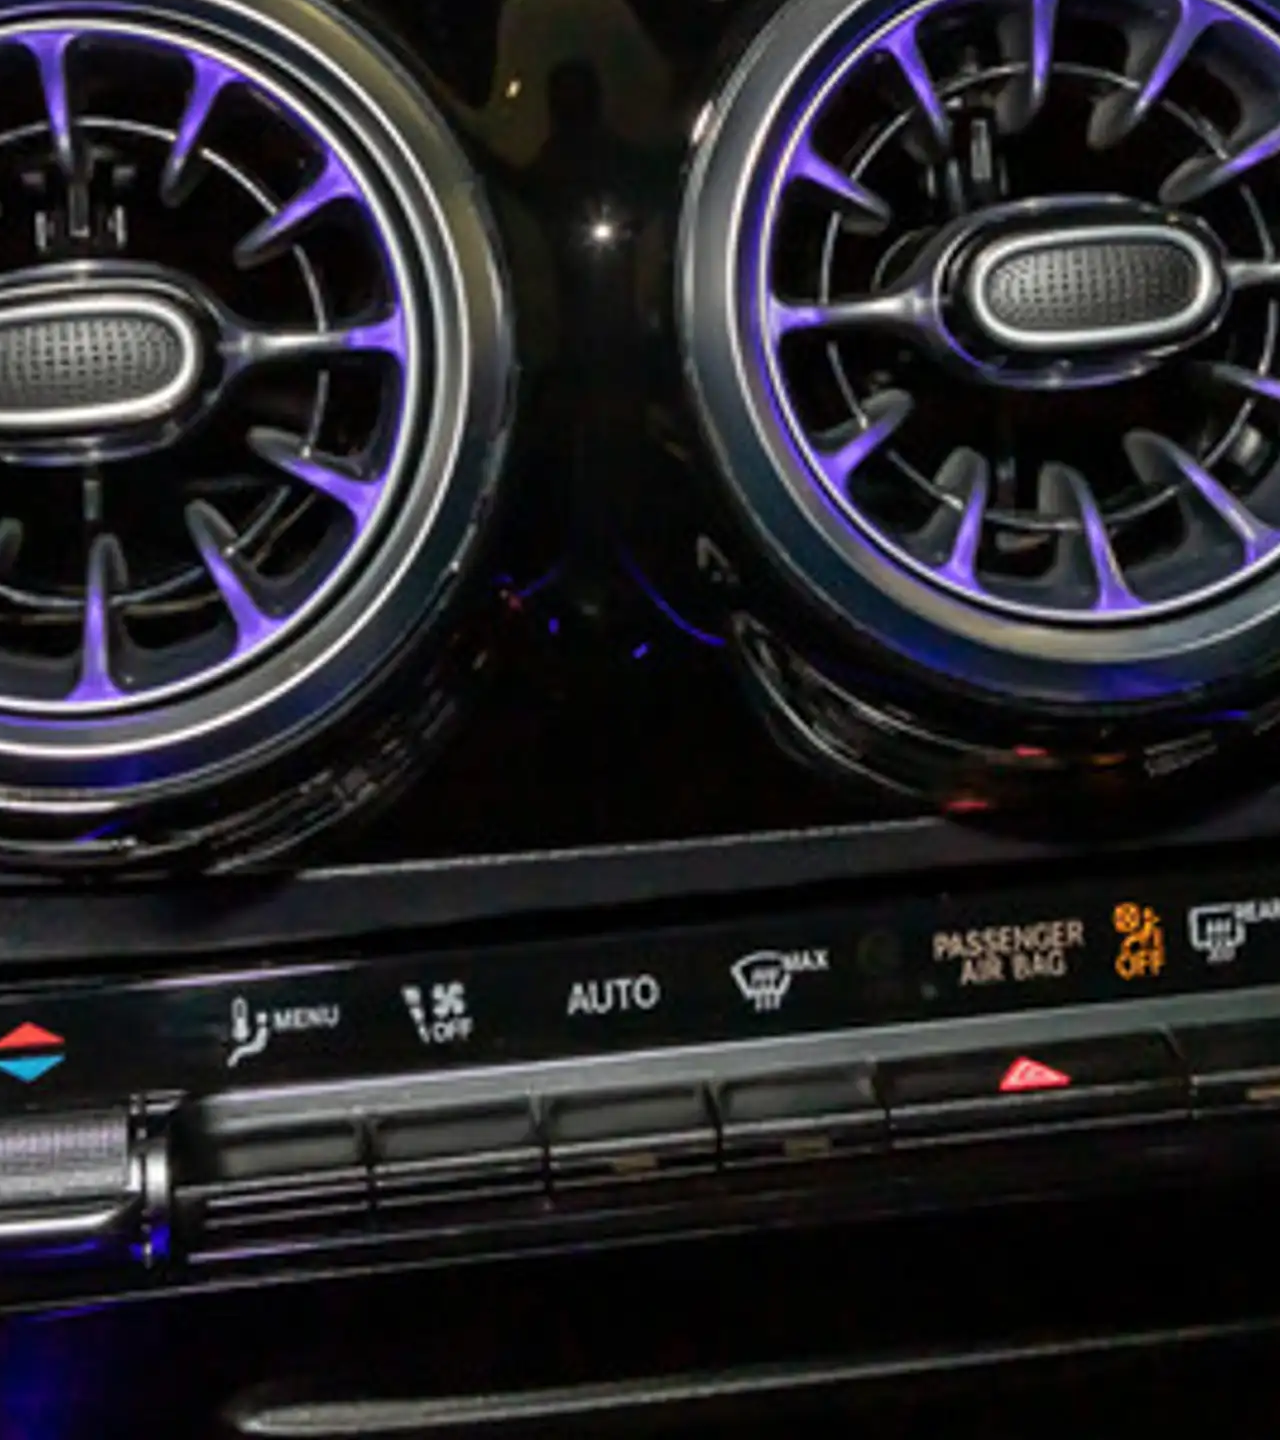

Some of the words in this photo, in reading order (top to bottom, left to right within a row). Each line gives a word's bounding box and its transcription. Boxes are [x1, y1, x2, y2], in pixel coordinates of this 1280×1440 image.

[933, 920, 1085, 960] PASSENGER
[782, 949, 830, 972] MAX
[960, 959, 1006, 986] AIR
[1014, 951, 1067, 980] BAG
[1115, 955, 1165, 981] OFF
[567, 975, 661, 1016] AUTO
[273, 1005, 340, 1034] MENU
[431, 1018, 475, 1044] OFF
